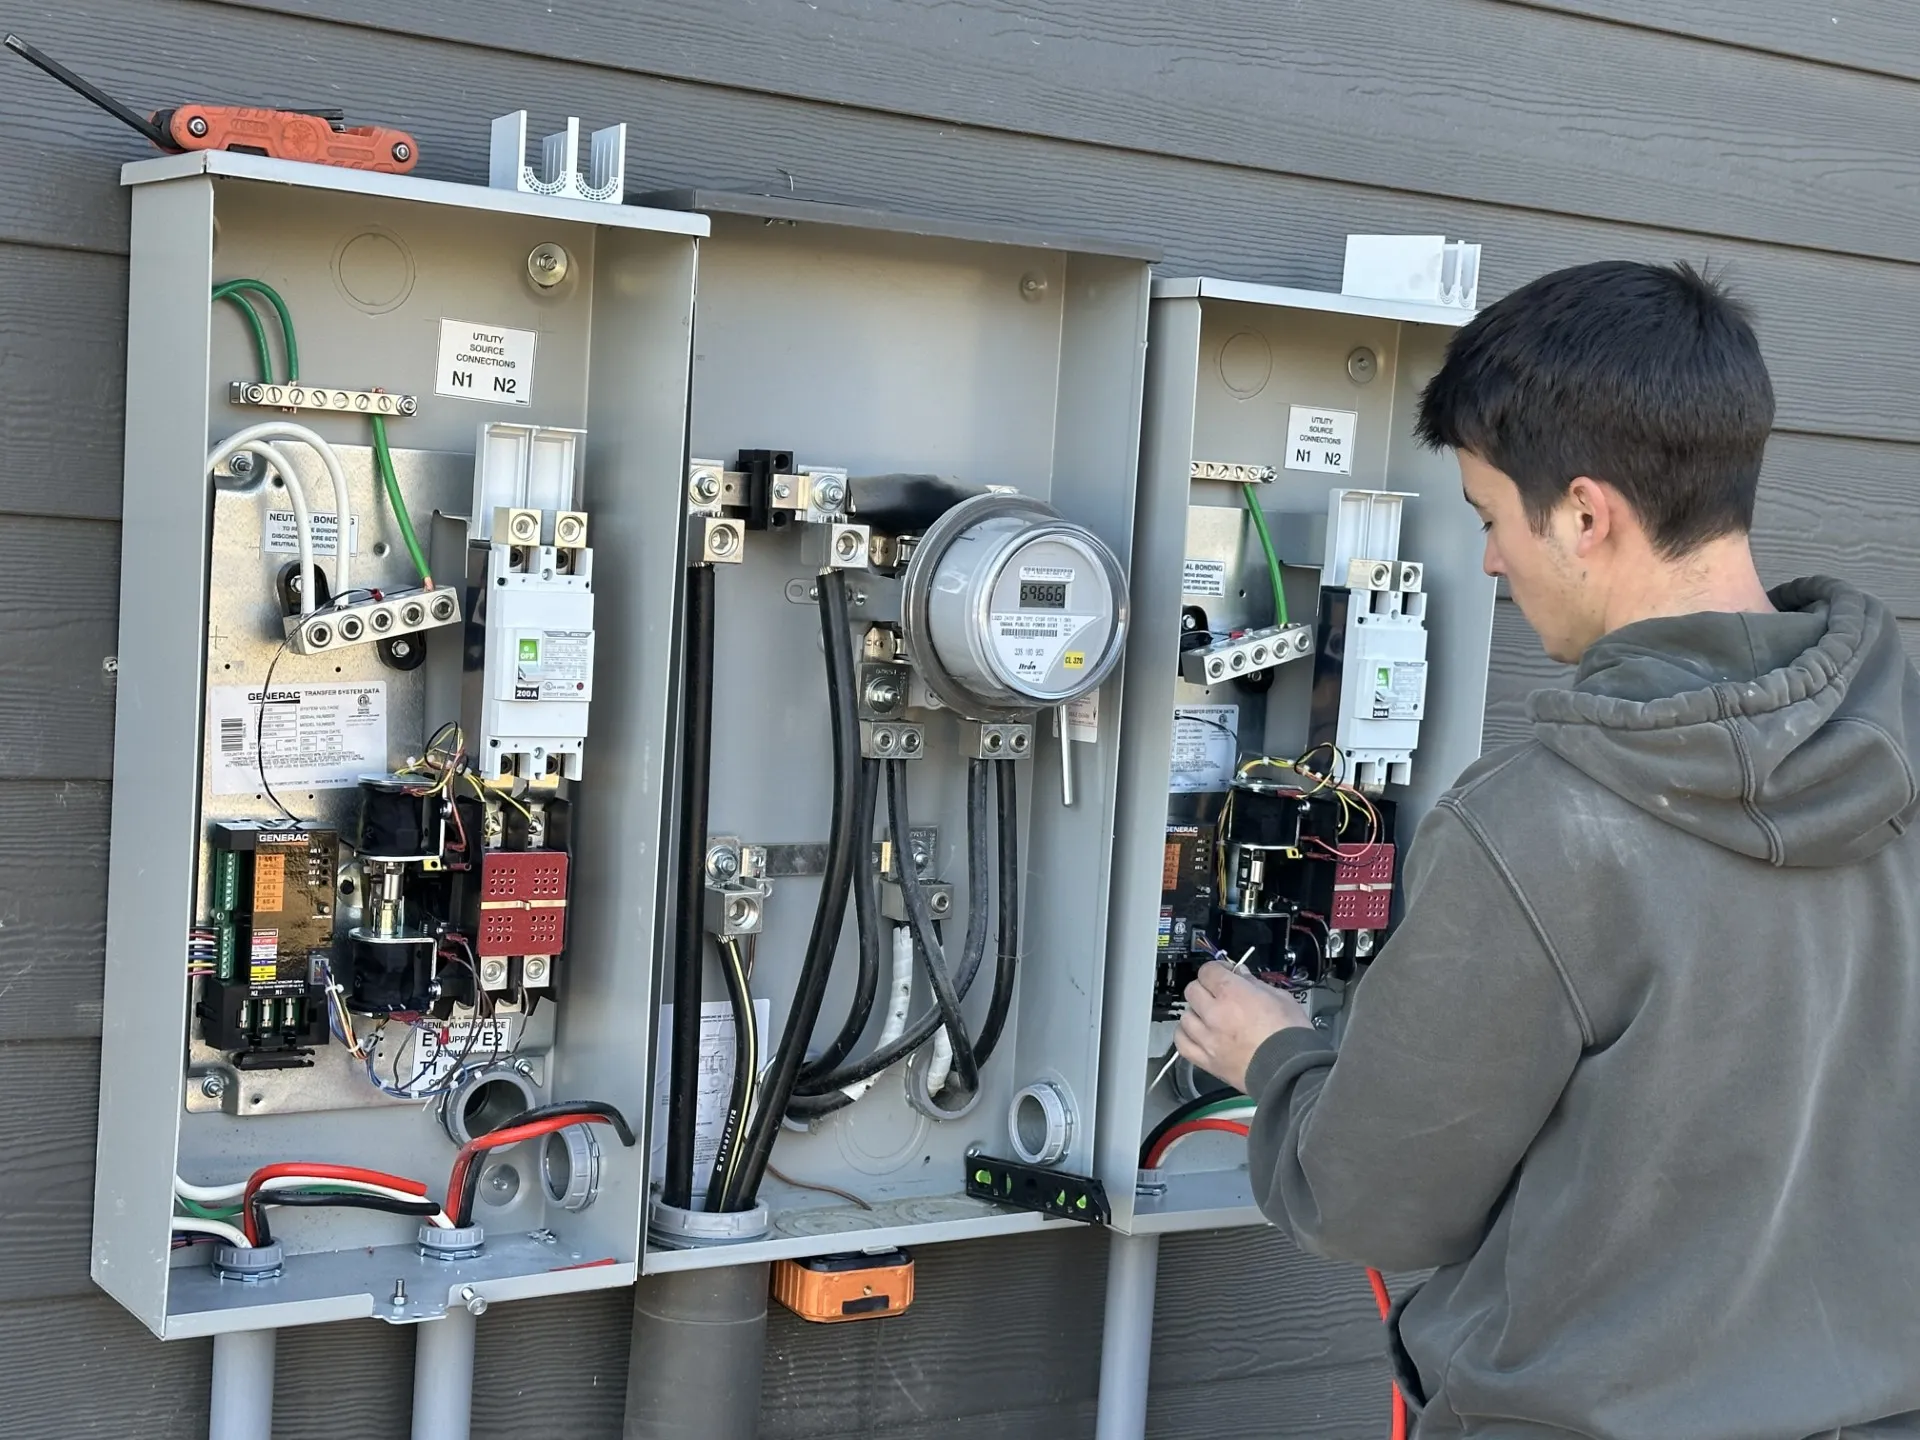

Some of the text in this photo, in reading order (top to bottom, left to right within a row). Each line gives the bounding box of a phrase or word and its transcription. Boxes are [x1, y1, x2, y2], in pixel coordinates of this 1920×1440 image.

[473, 332, 504, 344] UTILITY
[470, 344, 504, 355] SOURCE
[456, 354, 515, 368] CONNECTIONS
[452, 371, 516, 393] N1 N2
[1312, 416, 1333, 424] UTILITY
[1310, 426, 1333, 434] SOURCE
[1300, 435, 1341, 445] CONNECTIONS
[1296, 448, 1341, 465] N1 N2
[1020, 586, 1062, 601] 69666
[1019, 661, 1036, 669] Itron
[248, 692, 300, 700] GENERAC
[483, 1032, 502, 1046] E2
[420, 1061, 437, 1075] T1
